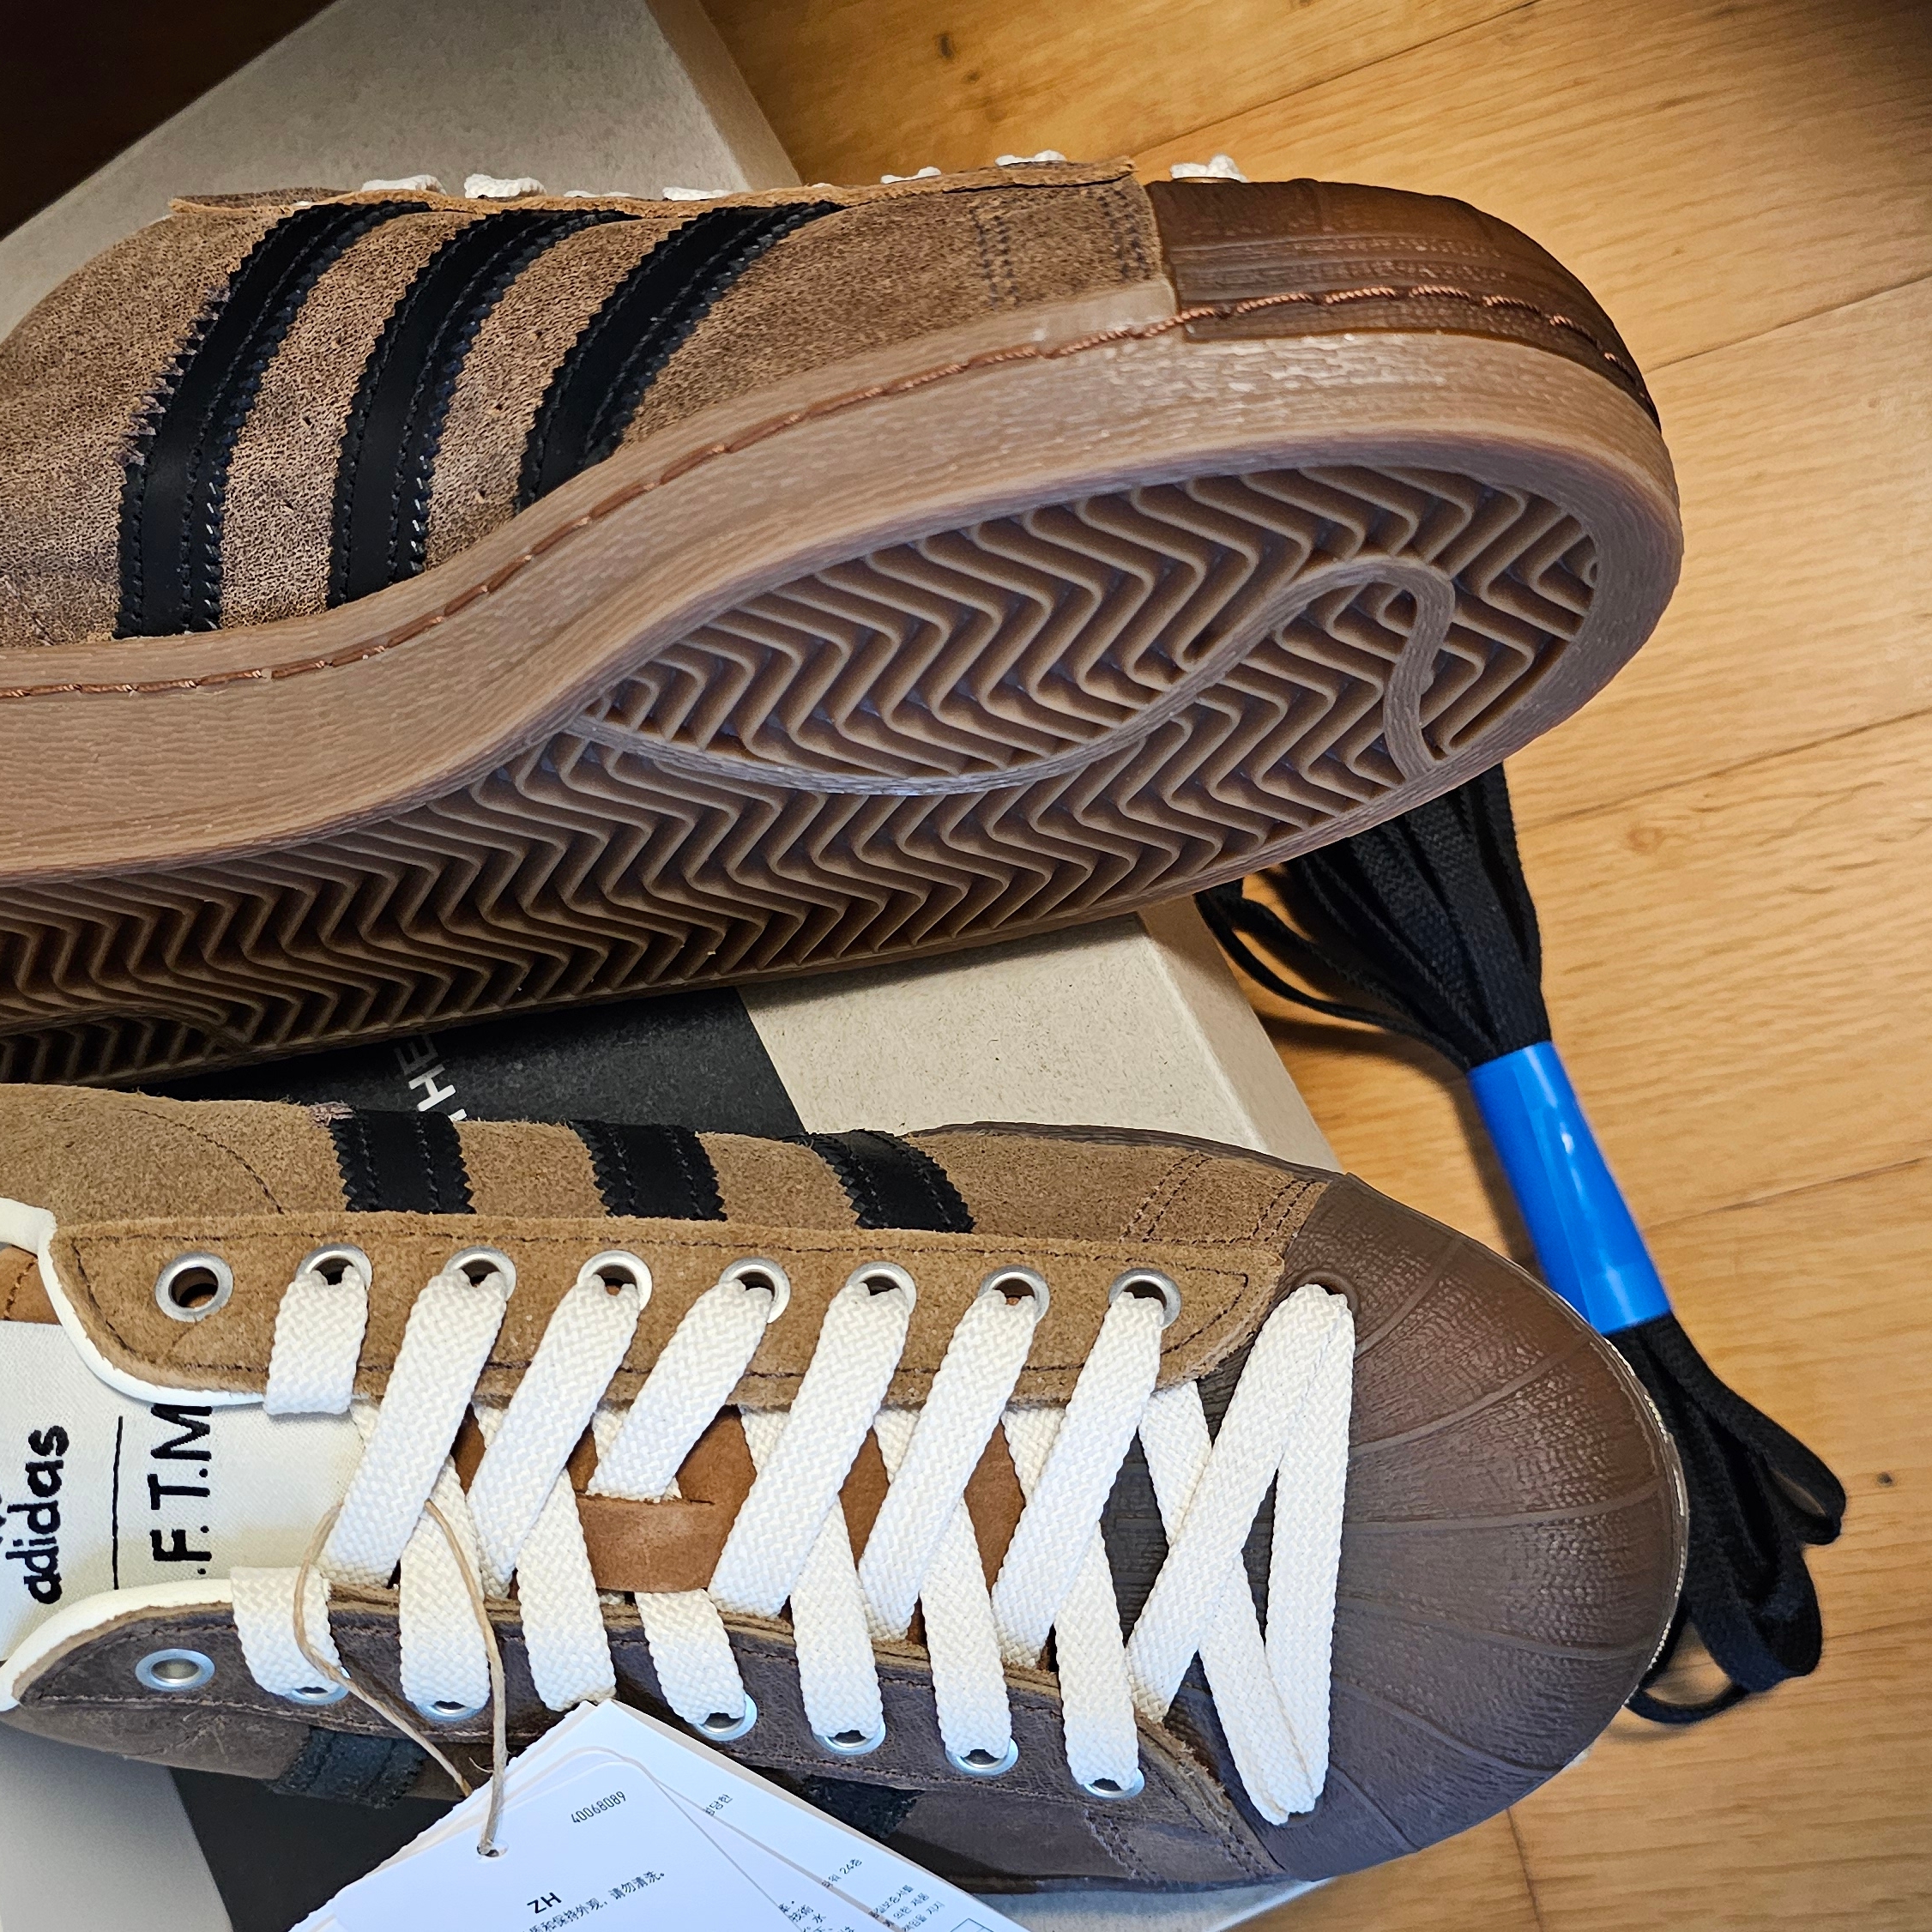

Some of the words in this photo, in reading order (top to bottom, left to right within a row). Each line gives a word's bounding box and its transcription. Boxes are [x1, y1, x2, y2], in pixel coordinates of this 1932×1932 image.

[5, 1425, 69, 1604] adidas
[571, 1790, 627, 1824] 40068089
[526, 1892, 562, 1914] ZH
